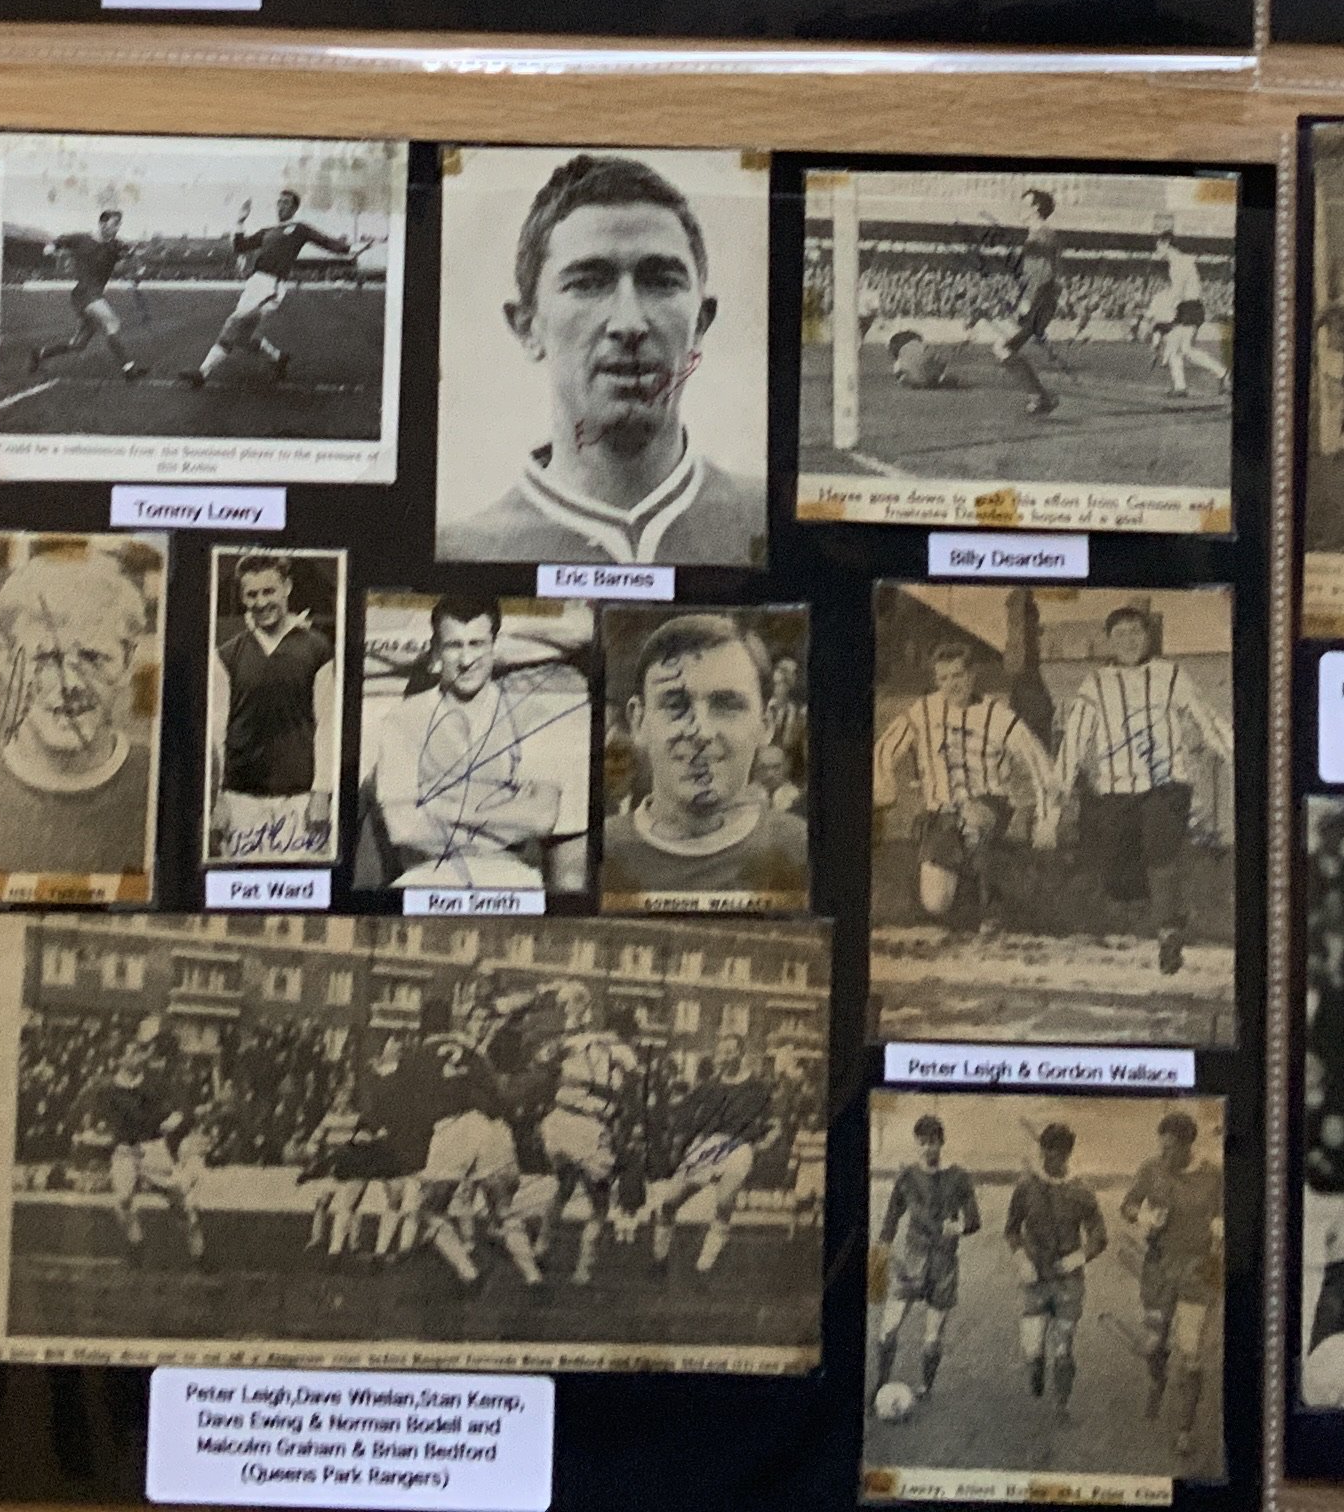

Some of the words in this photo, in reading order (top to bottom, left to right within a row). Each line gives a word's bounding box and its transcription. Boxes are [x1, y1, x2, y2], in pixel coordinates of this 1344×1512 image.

[134, 501, 203, 522] Tommy
[208, 501, 263, 524] Lowry
[949, 548, 986, 570] Billy
[990, 548, 1065, 568] Dearden
[555, 567, 588, 587] Eric
[593, 568, 655, 587] Barnes
[229, 881, 262, 900] Pat
[267, 880, 315, 900] Ward
[427, 893, 464, 911] Ron
[467, 893, 521, 911] Smith
[907, 1058, 956, 1076] Peter
[962, 1059, 1012, 1080] Leigh
[1017, 1060, 1031, 1079] &
[1036, 1061, 1103, 1080] Gordon
[1109, 1064, 1178, 1083] Wallace
[185, 1383, 236, 1403] Peter
[467, 1390, 526, 1413] Kemp,
[197, 1409, 244, 1429] Dave
[249, 1411, 303, 1434] Ewing
[308, 1412, 323, 1430] &
[329, 1413, 401, 1433] Norman
[406, 1414, 462, 1434] Bodell
[467, 1416, 501, 1436] and
[196, 1436, 272, 1455] Malcolm
[276, 1437, 347, 1458] Graham
[351, 1439, 366, 1459] &
[371, 1440, 418, 1459] Brian
[423, 1441, 497, 1462] Bedford
[240, 1461, 316, 1485] (Queens
[321, 1464, 362, 1484] Park
[367, 1466, 450, 1490] Rangers)
